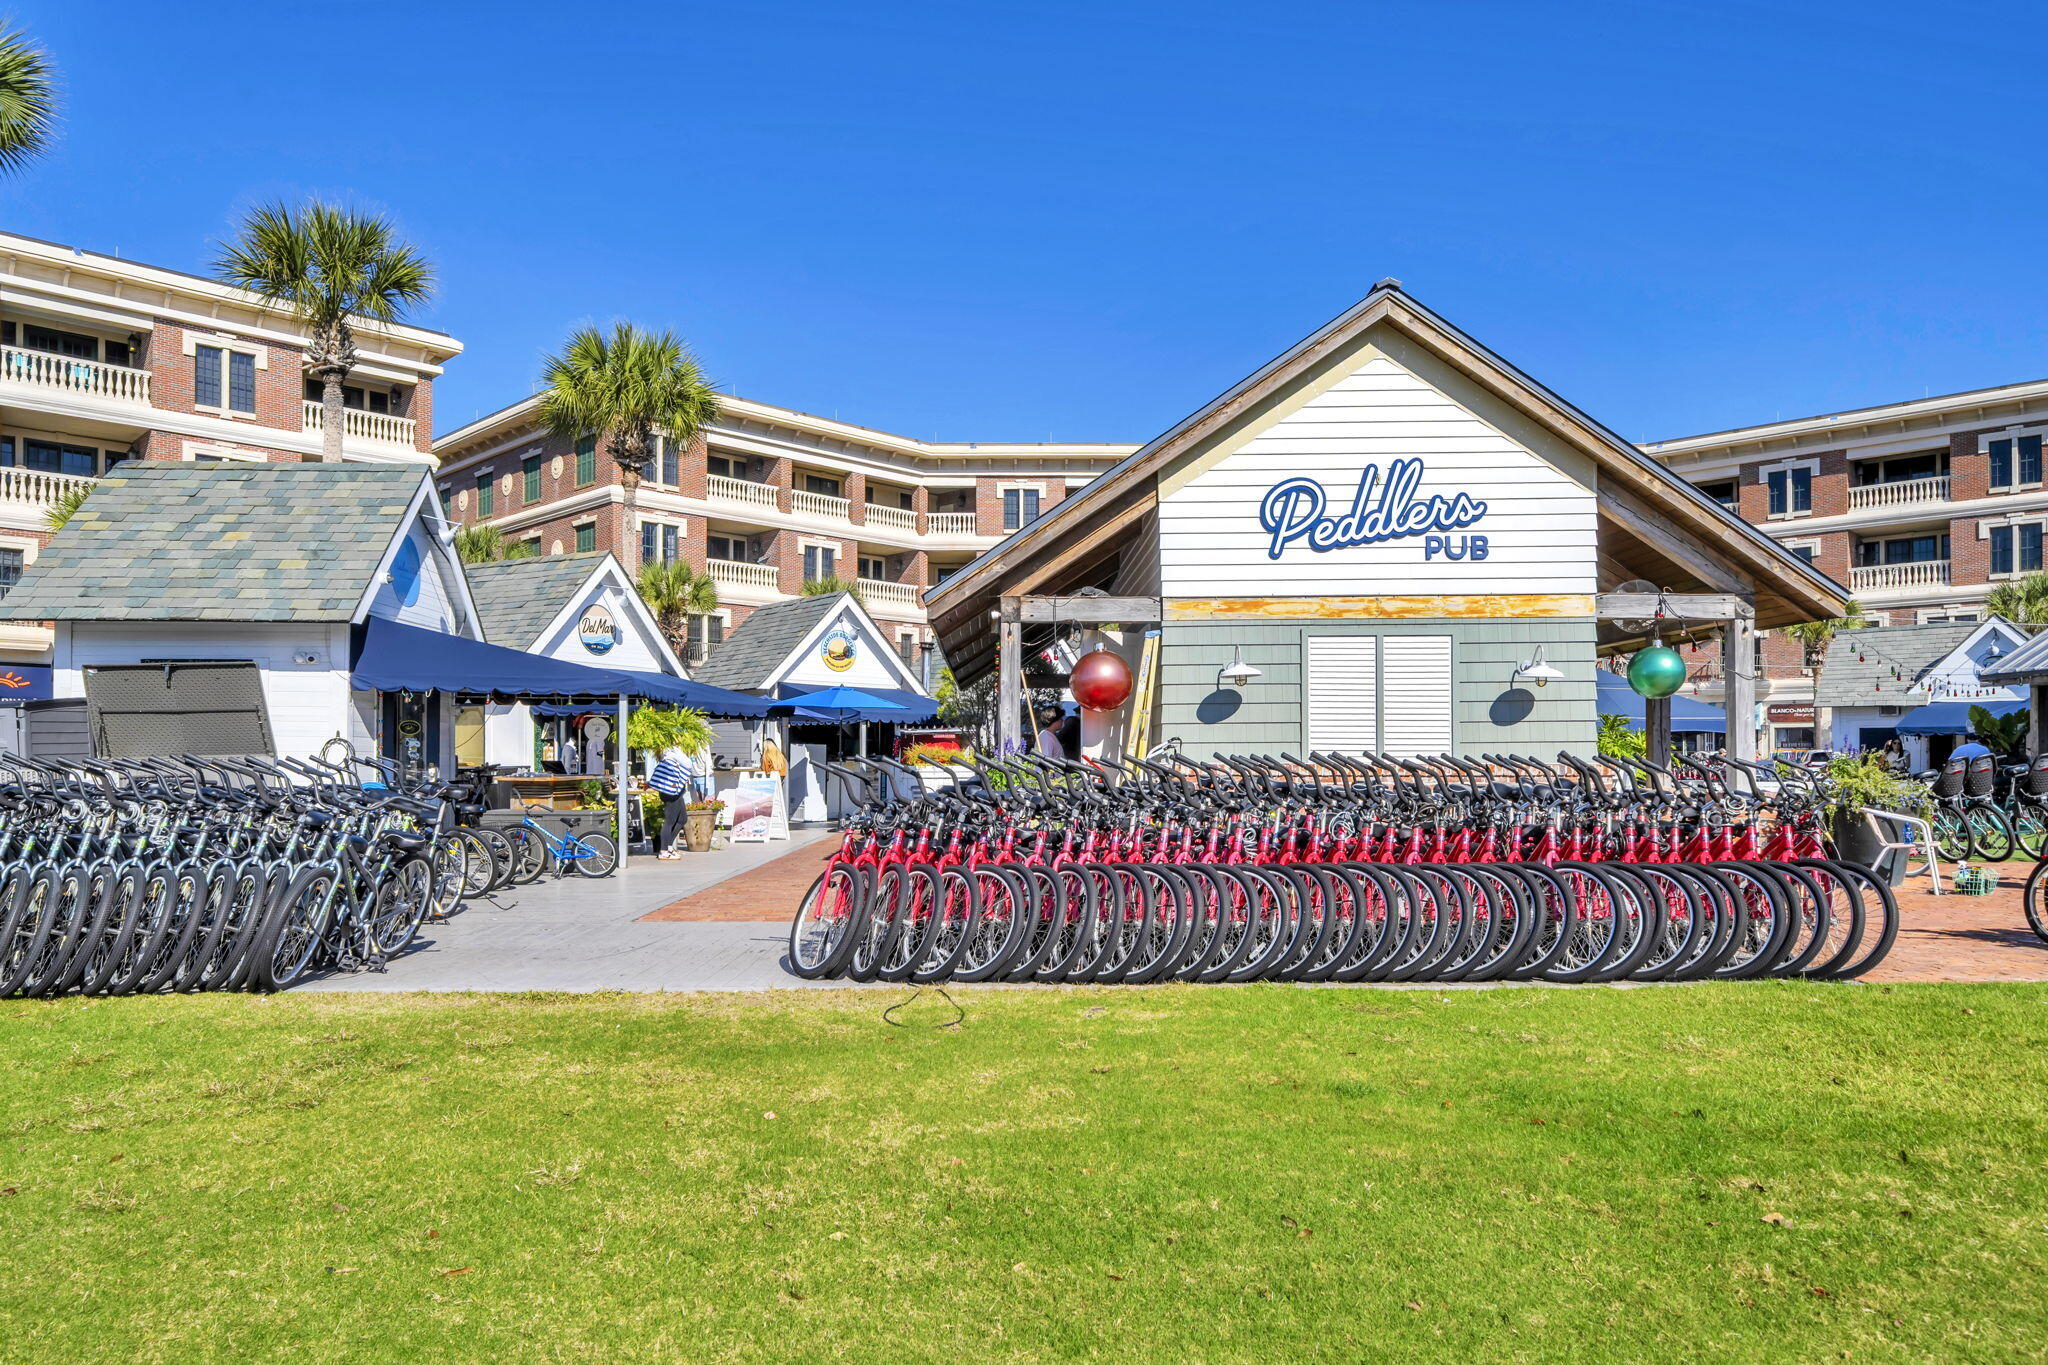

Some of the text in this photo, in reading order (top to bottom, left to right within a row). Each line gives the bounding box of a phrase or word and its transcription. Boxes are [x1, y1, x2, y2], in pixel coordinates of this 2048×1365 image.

[1260, 457, 1487, 560] Peddlers
[1425, 535, 1489, 561] PUB
[582, 617, 614, 635] Del Mar
